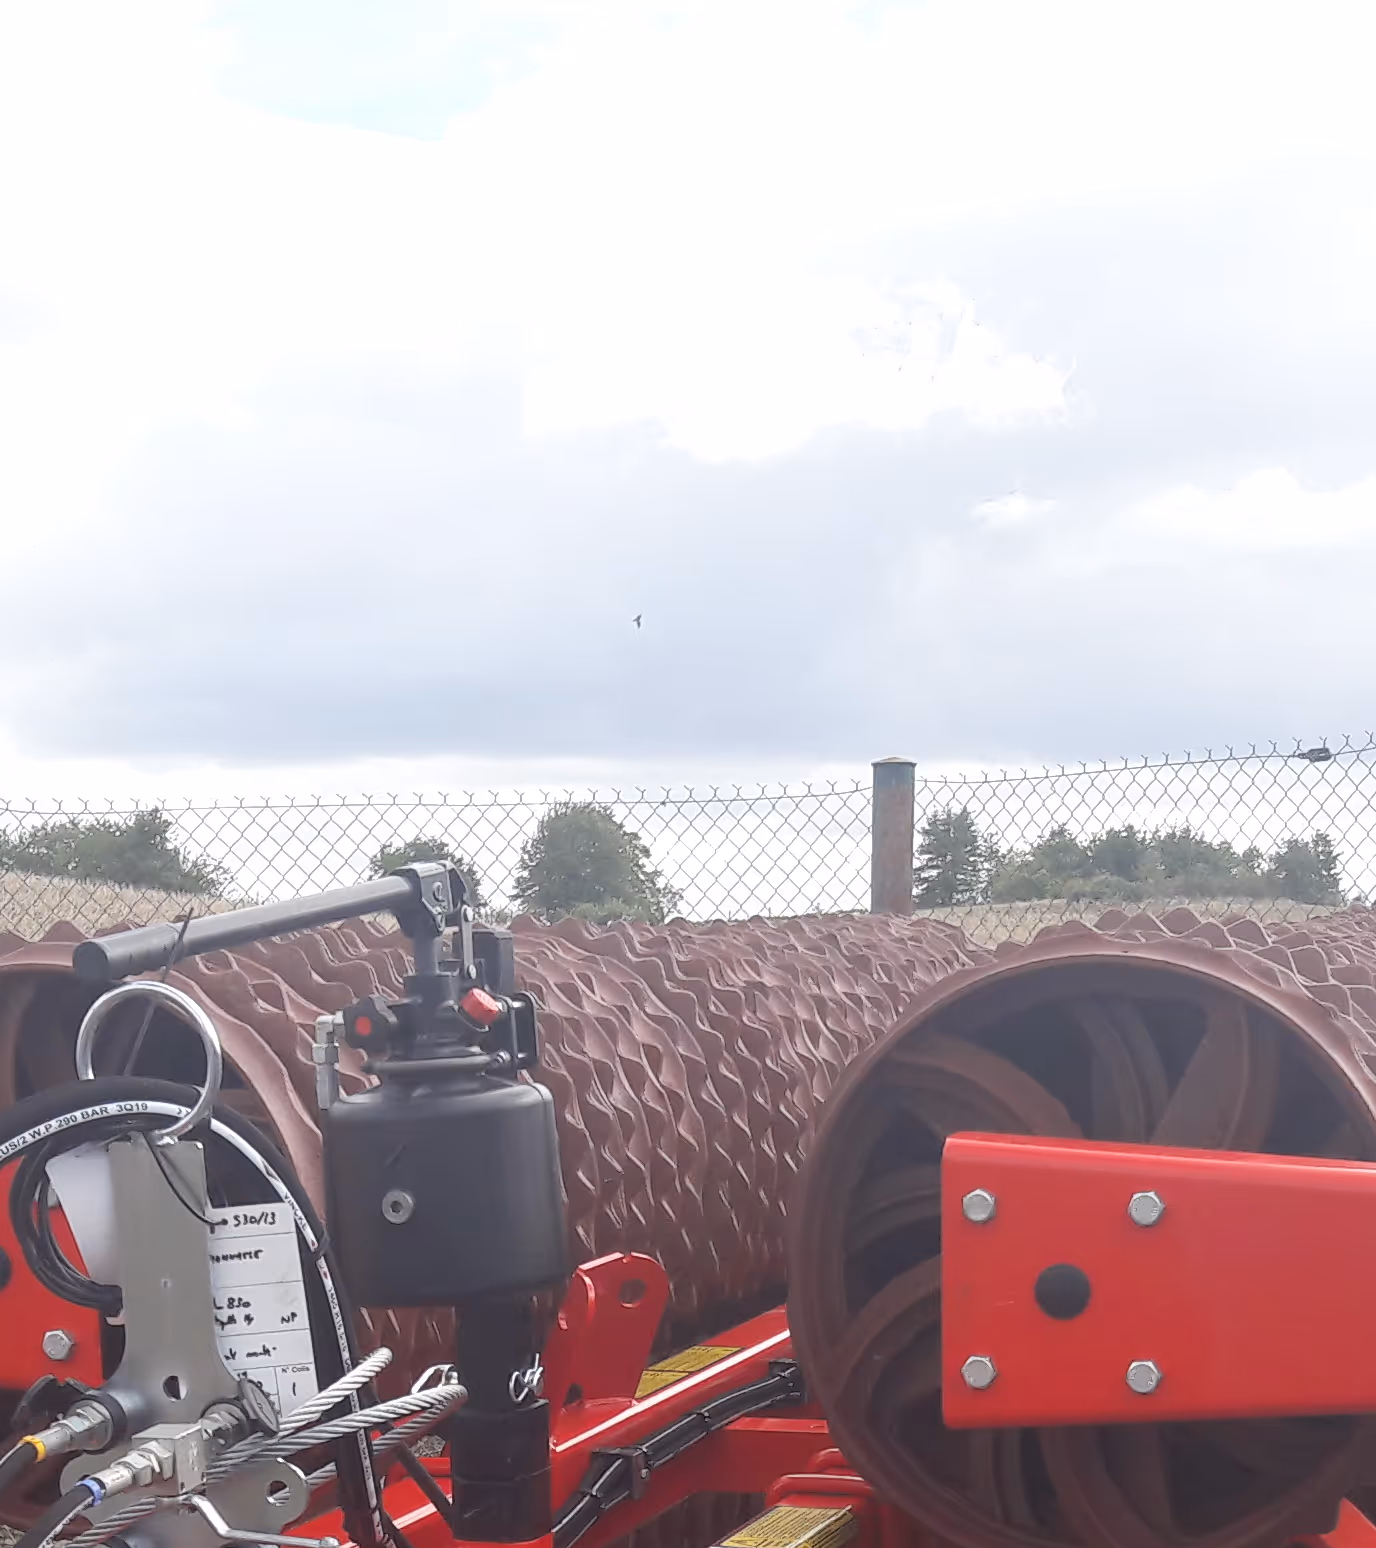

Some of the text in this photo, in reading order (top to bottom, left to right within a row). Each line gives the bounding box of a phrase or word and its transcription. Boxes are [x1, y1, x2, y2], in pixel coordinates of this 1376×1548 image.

[29, 1114, 79, 1140] W.P.290
[80, 1106, 110, 1120] BAR
[115, 1102, 149, 1113] 3Q19
